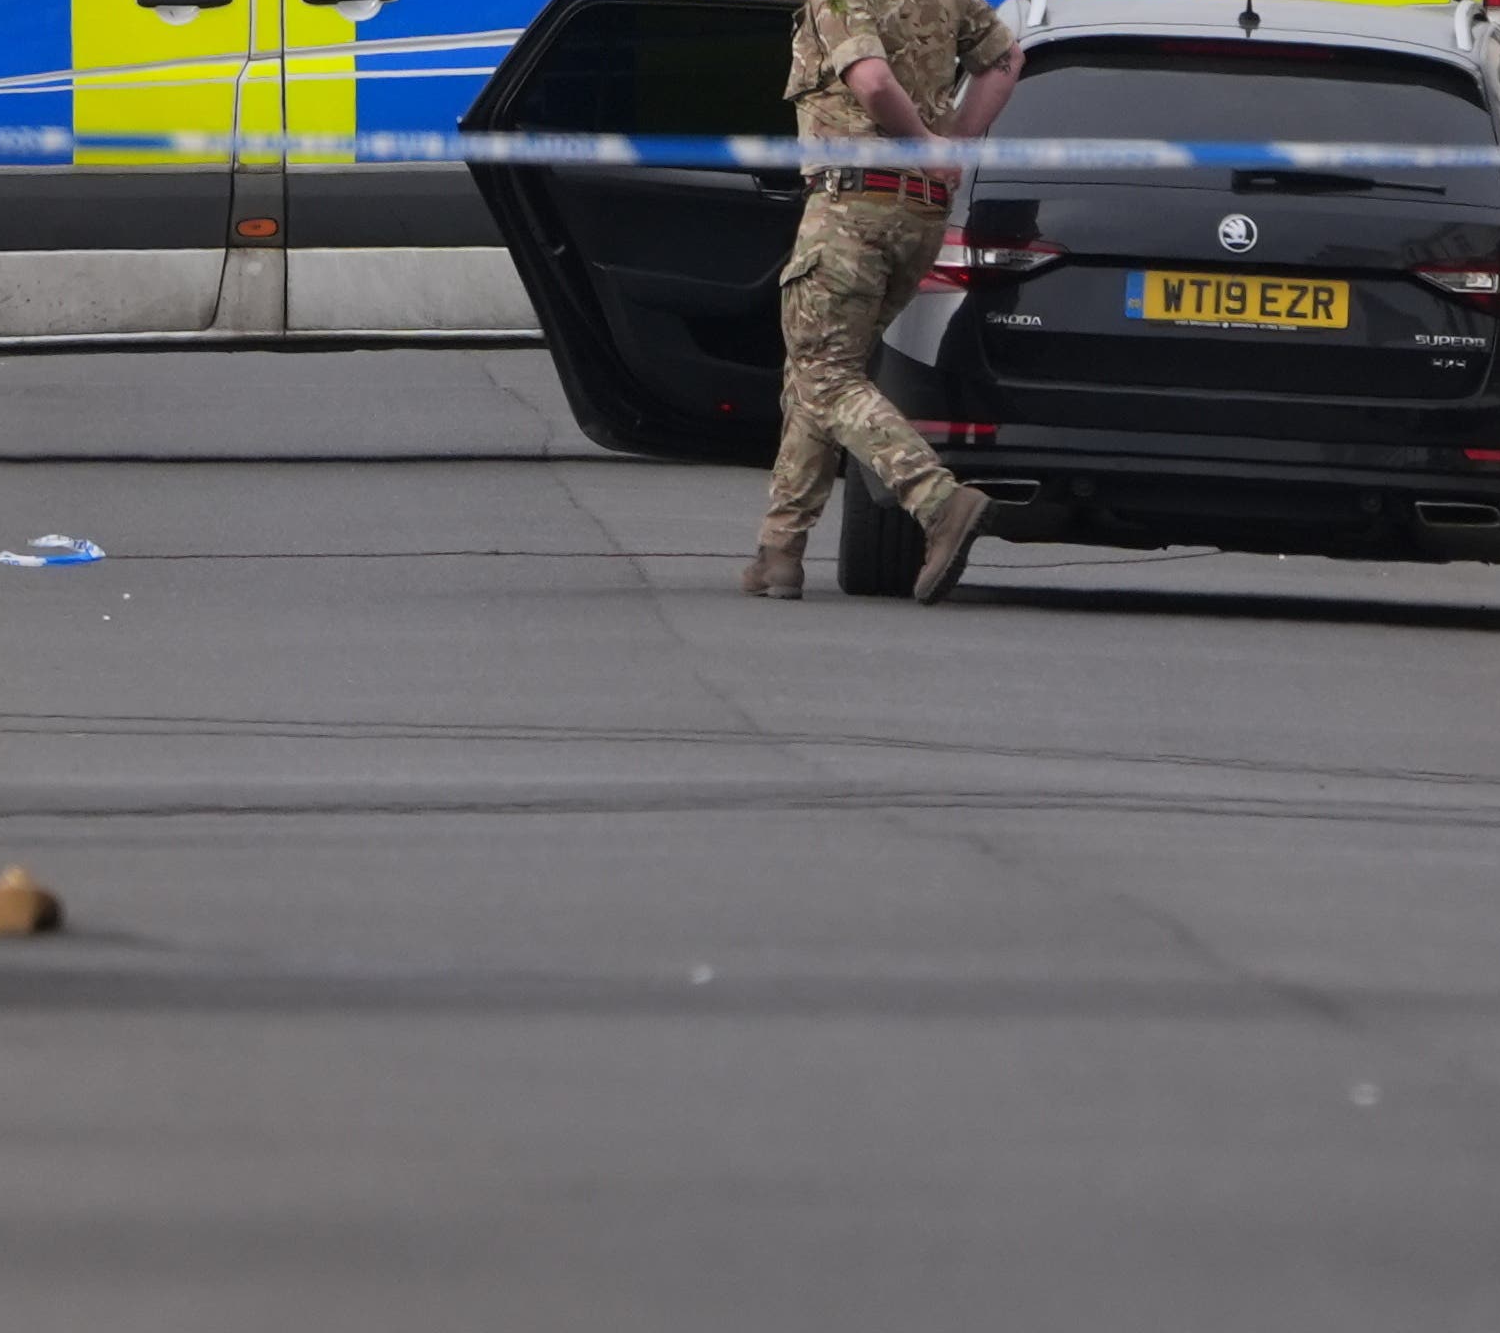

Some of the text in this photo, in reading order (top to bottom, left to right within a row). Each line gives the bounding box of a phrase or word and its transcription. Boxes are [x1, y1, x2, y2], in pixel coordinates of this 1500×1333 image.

[1162, 278, 1335, 321] WT19 EZR
[1415, 334, 1487, 348] SUPERB
